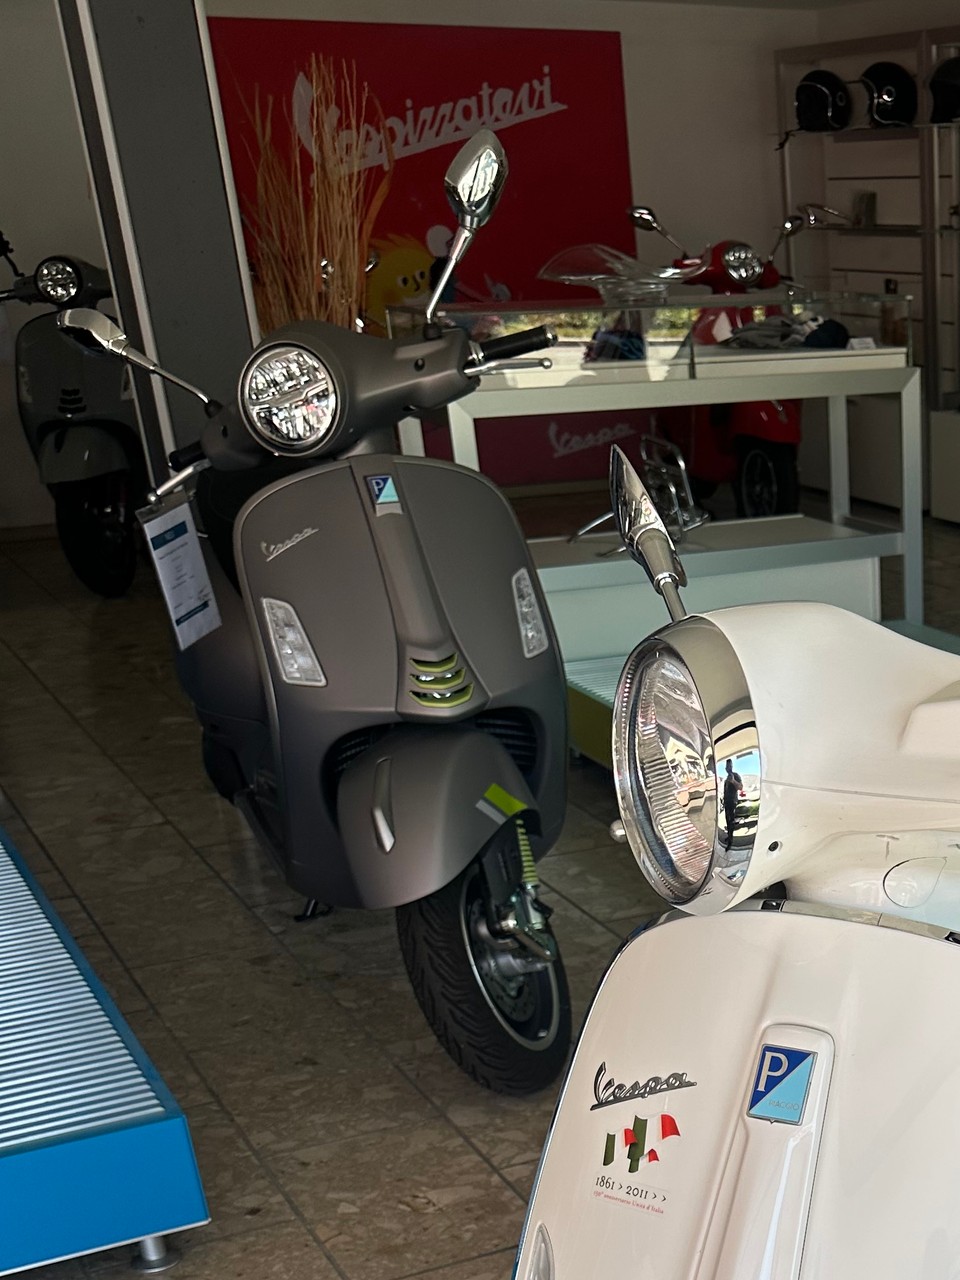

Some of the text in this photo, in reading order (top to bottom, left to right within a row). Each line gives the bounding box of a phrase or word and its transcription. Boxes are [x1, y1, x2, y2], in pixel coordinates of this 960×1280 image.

[371, 479, 384, 495] P
[756, 1051, 789, 1092] P
[590, 1061, 697, 1111] Vespa
[768, 1100, 800, 1111] PIAGGIO
[595, 1175, 649, 1199] 1861 2011
